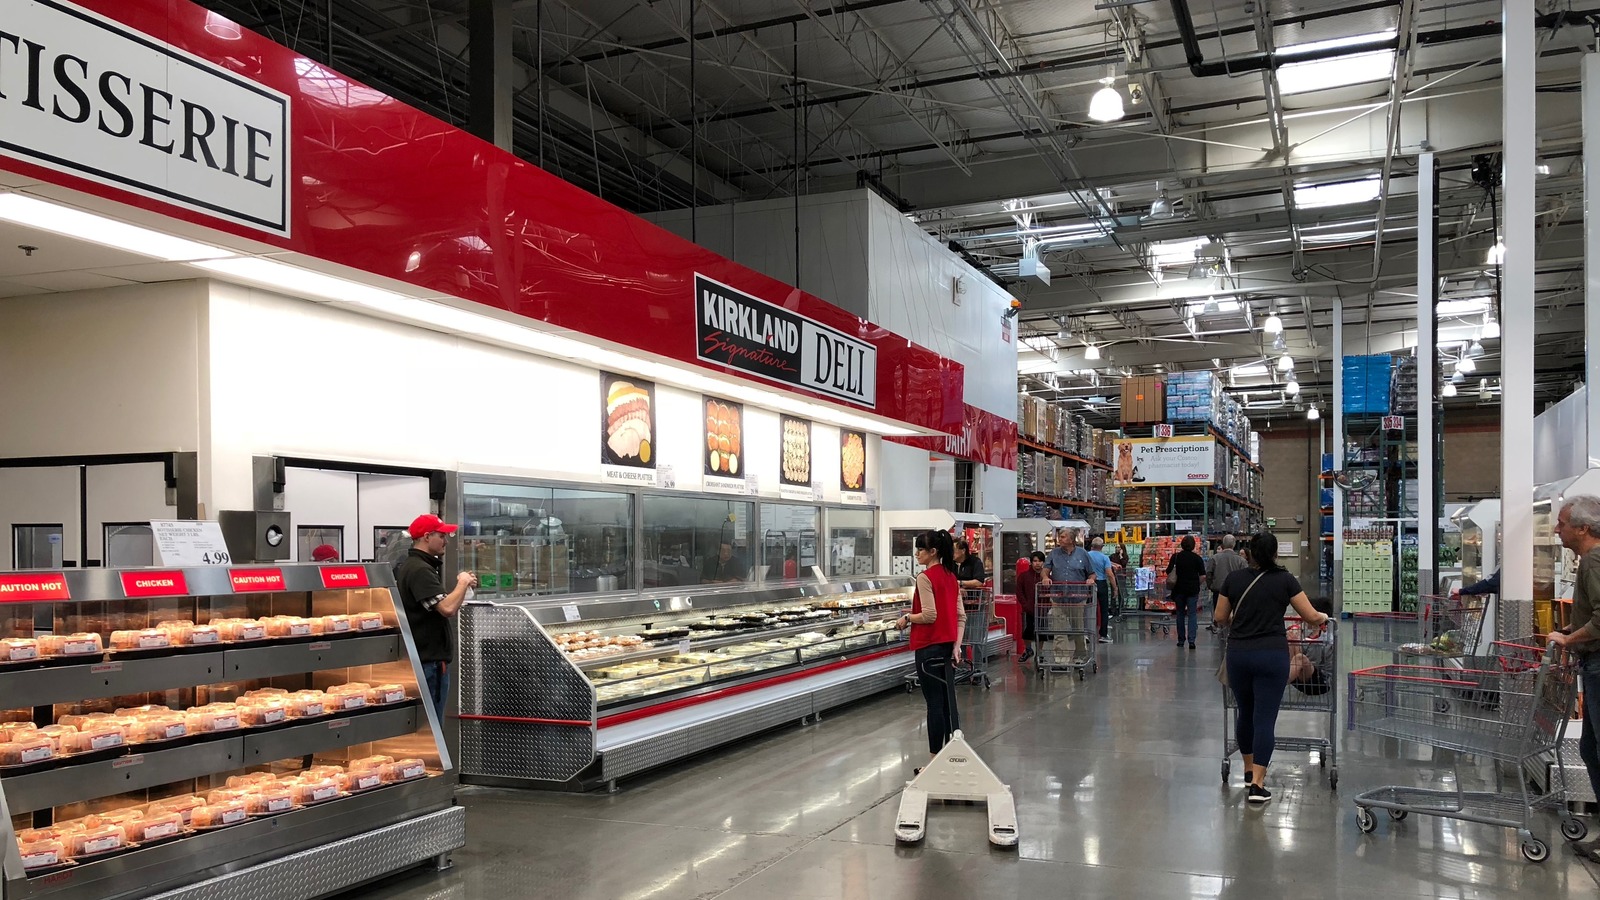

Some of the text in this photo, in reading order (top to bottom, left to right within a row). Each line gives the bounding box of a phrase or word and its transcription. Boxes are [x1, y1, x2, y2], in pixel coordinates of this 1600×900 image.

[703, 289, 865, 396] KIRKLAND DELI
[703, 332, 798, 372] Signature
[1160, 424, 1171, 436] 336
[1155, 445, 1209, 454] Prescriptions
[1148, 461, 1180, 469] pharmacist
[623, 472, 637, 480] CHEESE
[637, 473, 653, 481] PLATTER
[202, 551, 229, 564] 4.99
[135, 579, 174, 587] CHICKEN
